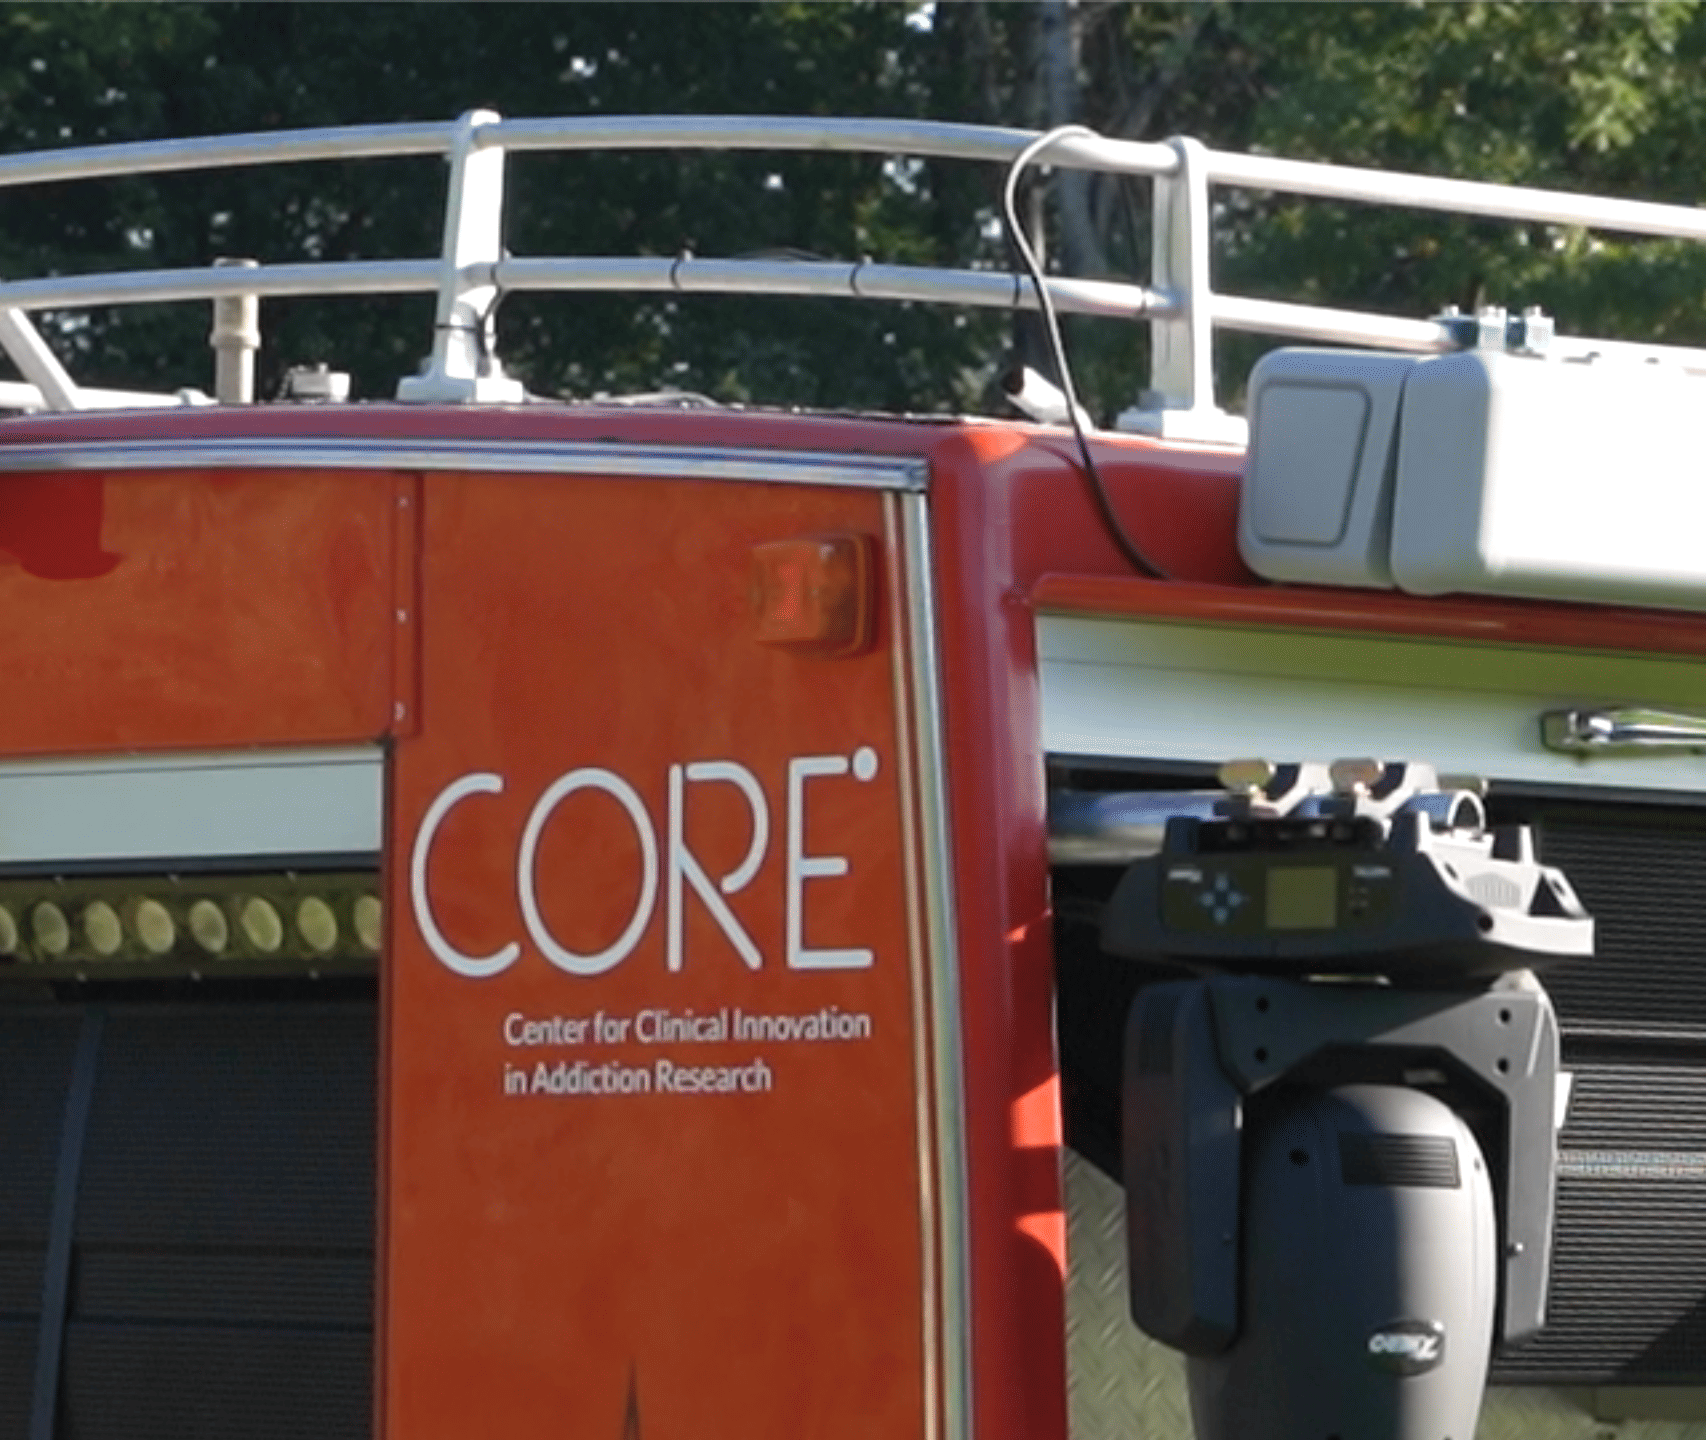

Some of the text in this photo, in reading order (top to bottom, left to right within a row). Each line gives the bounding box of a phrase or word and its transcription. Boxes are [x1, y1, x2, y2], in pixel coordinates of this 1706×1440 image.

[504, 1004, 872, 1045] Center for Clinical Innovation
[503, 1056, 773, 1095] in Addiction Research
